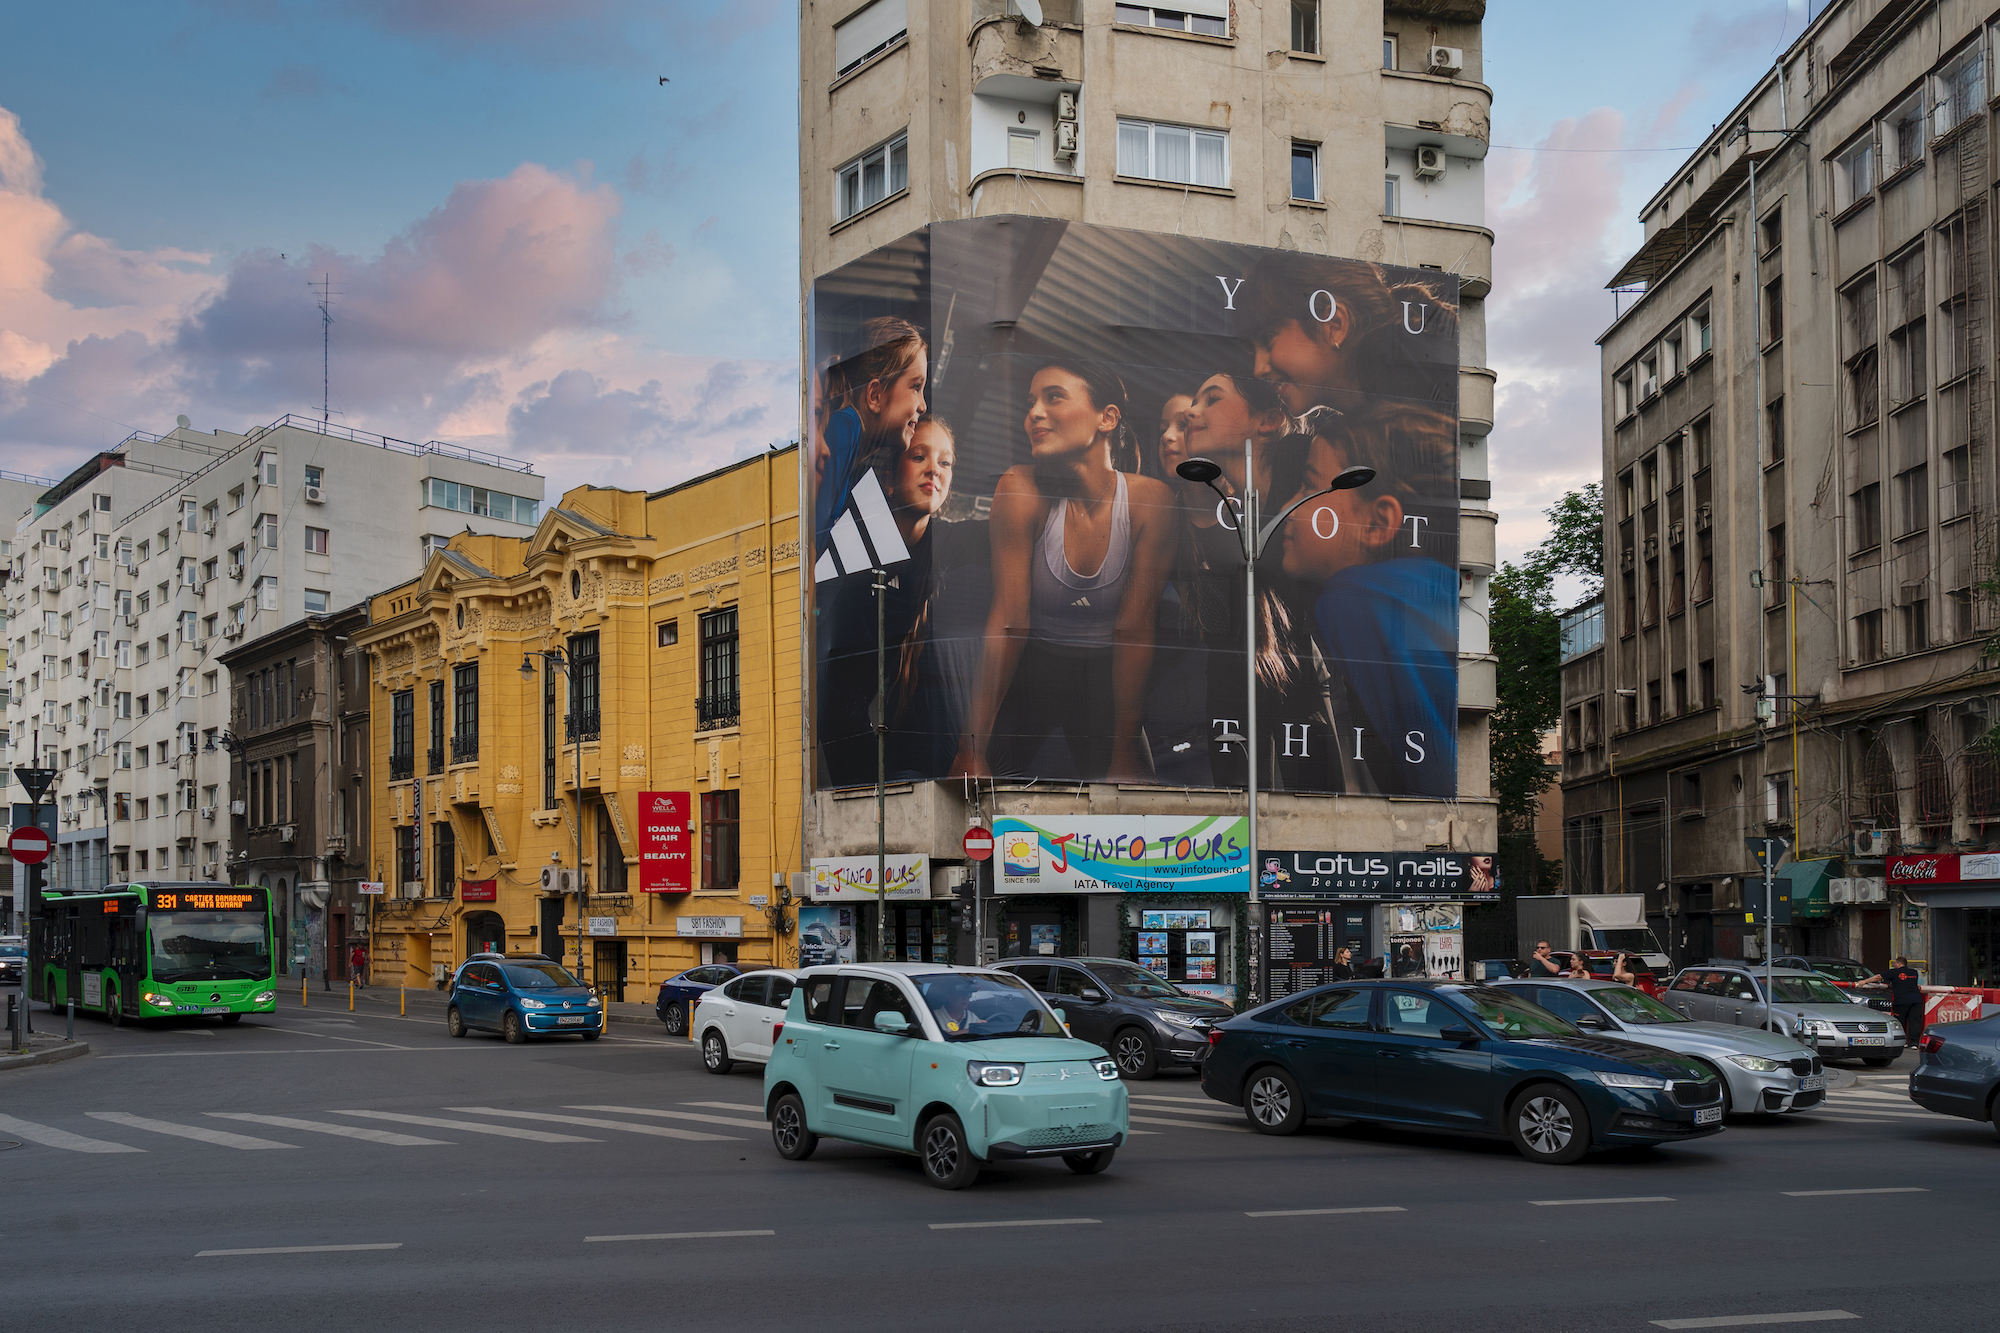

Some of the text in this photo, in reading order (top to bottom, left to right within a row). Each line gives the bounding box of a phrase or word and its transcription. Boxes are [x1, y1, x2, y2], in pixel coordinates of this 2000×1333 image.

[1215, 276, 1427, 334] YOU
[1216, 496, 1428, 547] GOT
[1213, 718, 1426, 763] THIS
[1051, 833, 1242, 873] J'INFO TOURS
[1153, 865, 1242, 875] www.jinfotours.ro
[1293, 853, 1463, 877] Lotus nails
[1890, 859, 1937, 879] Coca-Cola
[833, 865, 916, 893] J'INFO OURS
[1074, 880, 1175, 891] IATA Travel Agency
[1311, 878, 1457, 889] Beauty studio
[157, 894, 177, 908] 331
[691, 918, 726, 928] SBT FASHION
[1940, 1010, 1969, 1023] STOP
